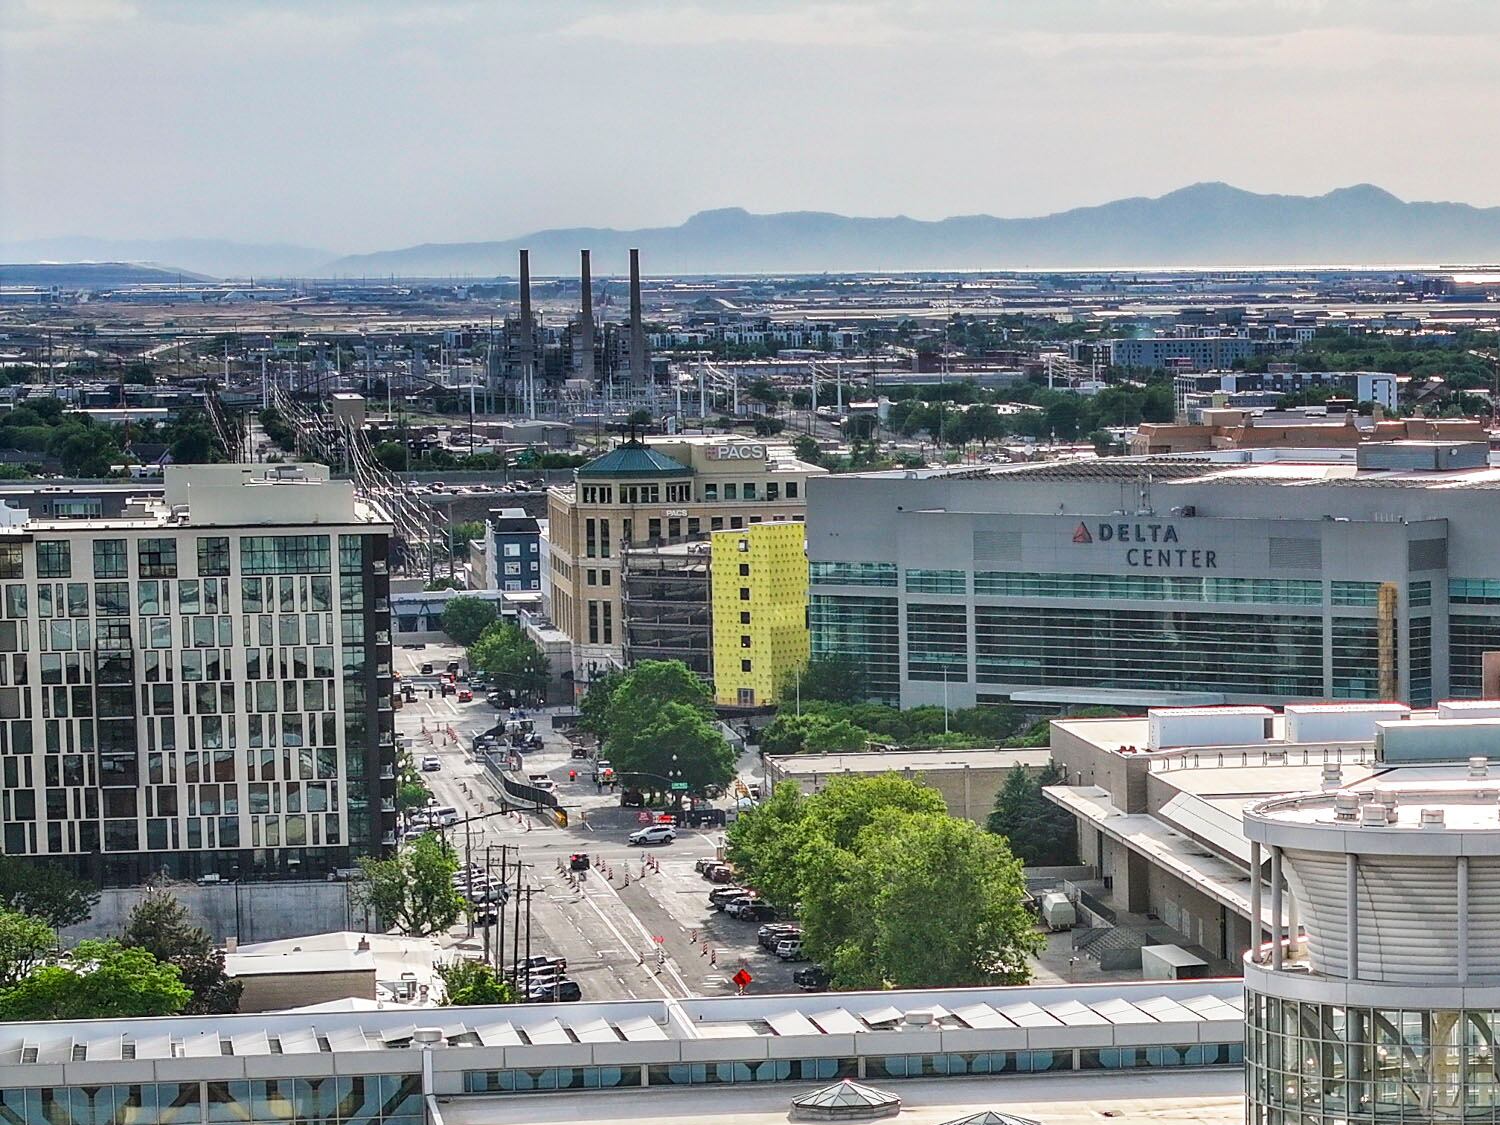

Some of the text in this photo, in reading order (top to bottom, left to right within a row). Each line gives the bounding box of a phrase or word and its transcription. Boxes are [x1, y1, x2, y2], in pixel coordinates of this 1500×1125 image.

[718, 445, 763, 459] PACS
[1099, 524, 1179, 542] DELTA
[1127, 549, 1217, 569] CENTER
